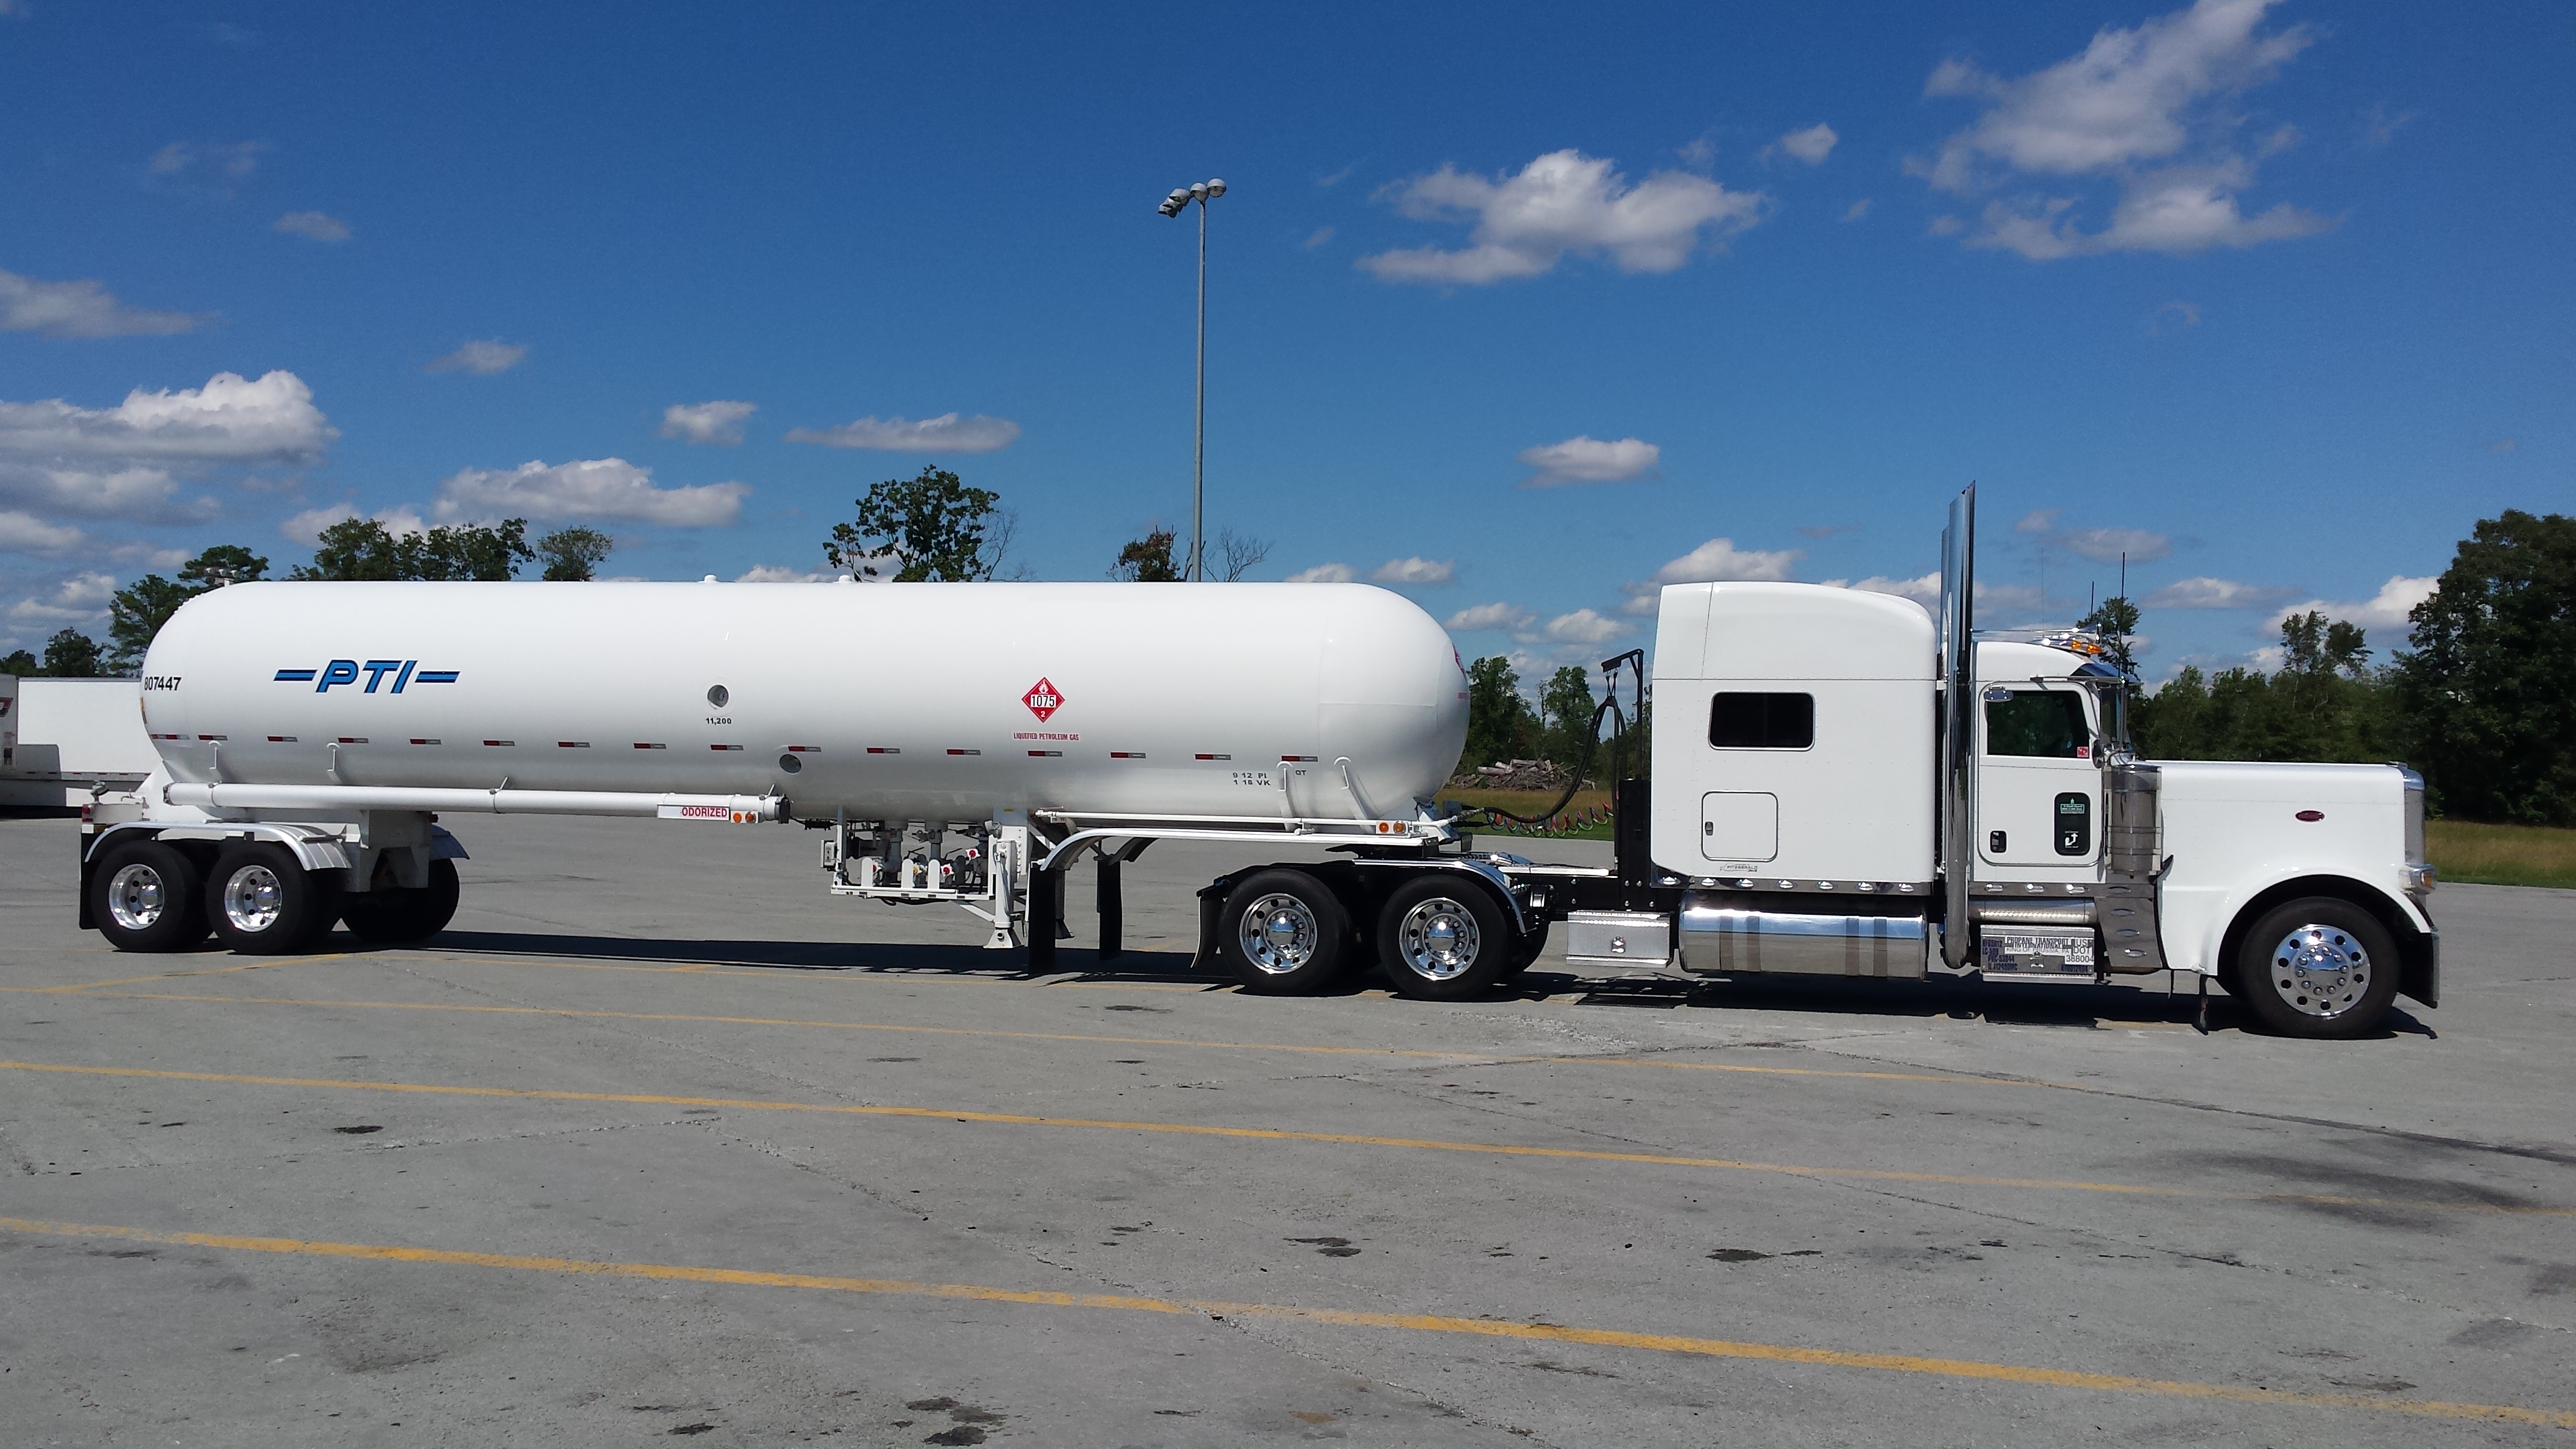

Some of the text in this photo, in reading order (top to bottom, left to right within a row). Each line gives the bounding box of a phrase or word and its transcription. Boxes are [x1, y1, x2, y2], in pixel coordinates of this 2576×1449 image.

[144, 676, 182, 691] 807447
[1032, 695, 1055, 707] 1075
[705, 717, 732, 725] 11,200
[681, 806, 727, 817] ODORIZED
[2007, 936, 2034, 944] PROPANE
[2036, 937, 2069, 945] TRANSPORT
[2073, 945, 2091, 954] DOT
